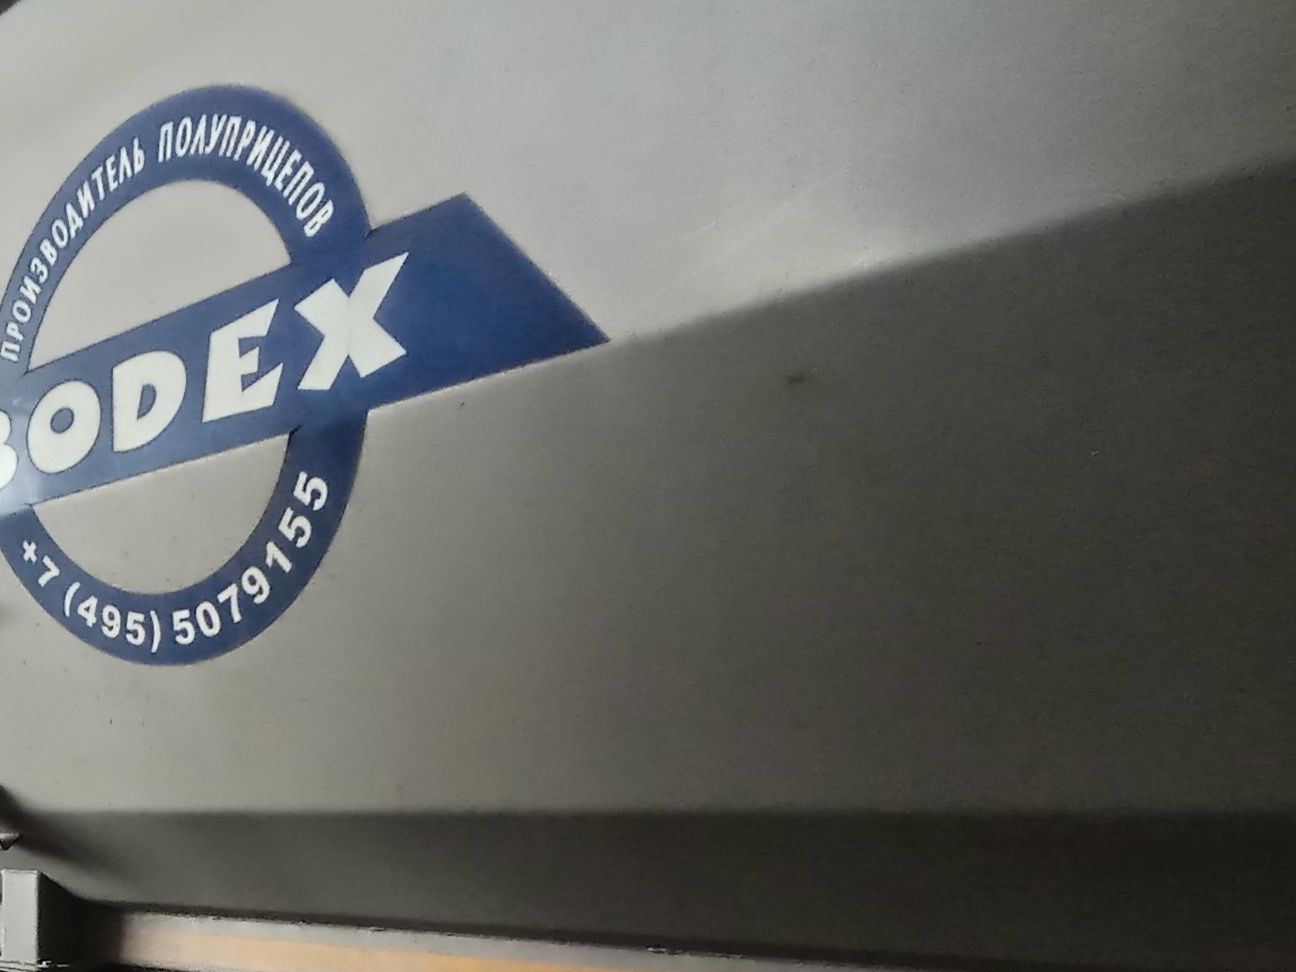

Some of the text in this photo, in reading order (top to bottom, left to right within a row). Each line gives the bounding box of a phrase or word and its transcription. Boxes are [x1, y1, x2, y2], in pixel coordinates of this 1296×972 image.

[0, 114, 335, 362] ПРОИЗВОДИТЕЛЬ ПОЛУПРИЦЕПОВ
[22, 540, 61, 588] +7
